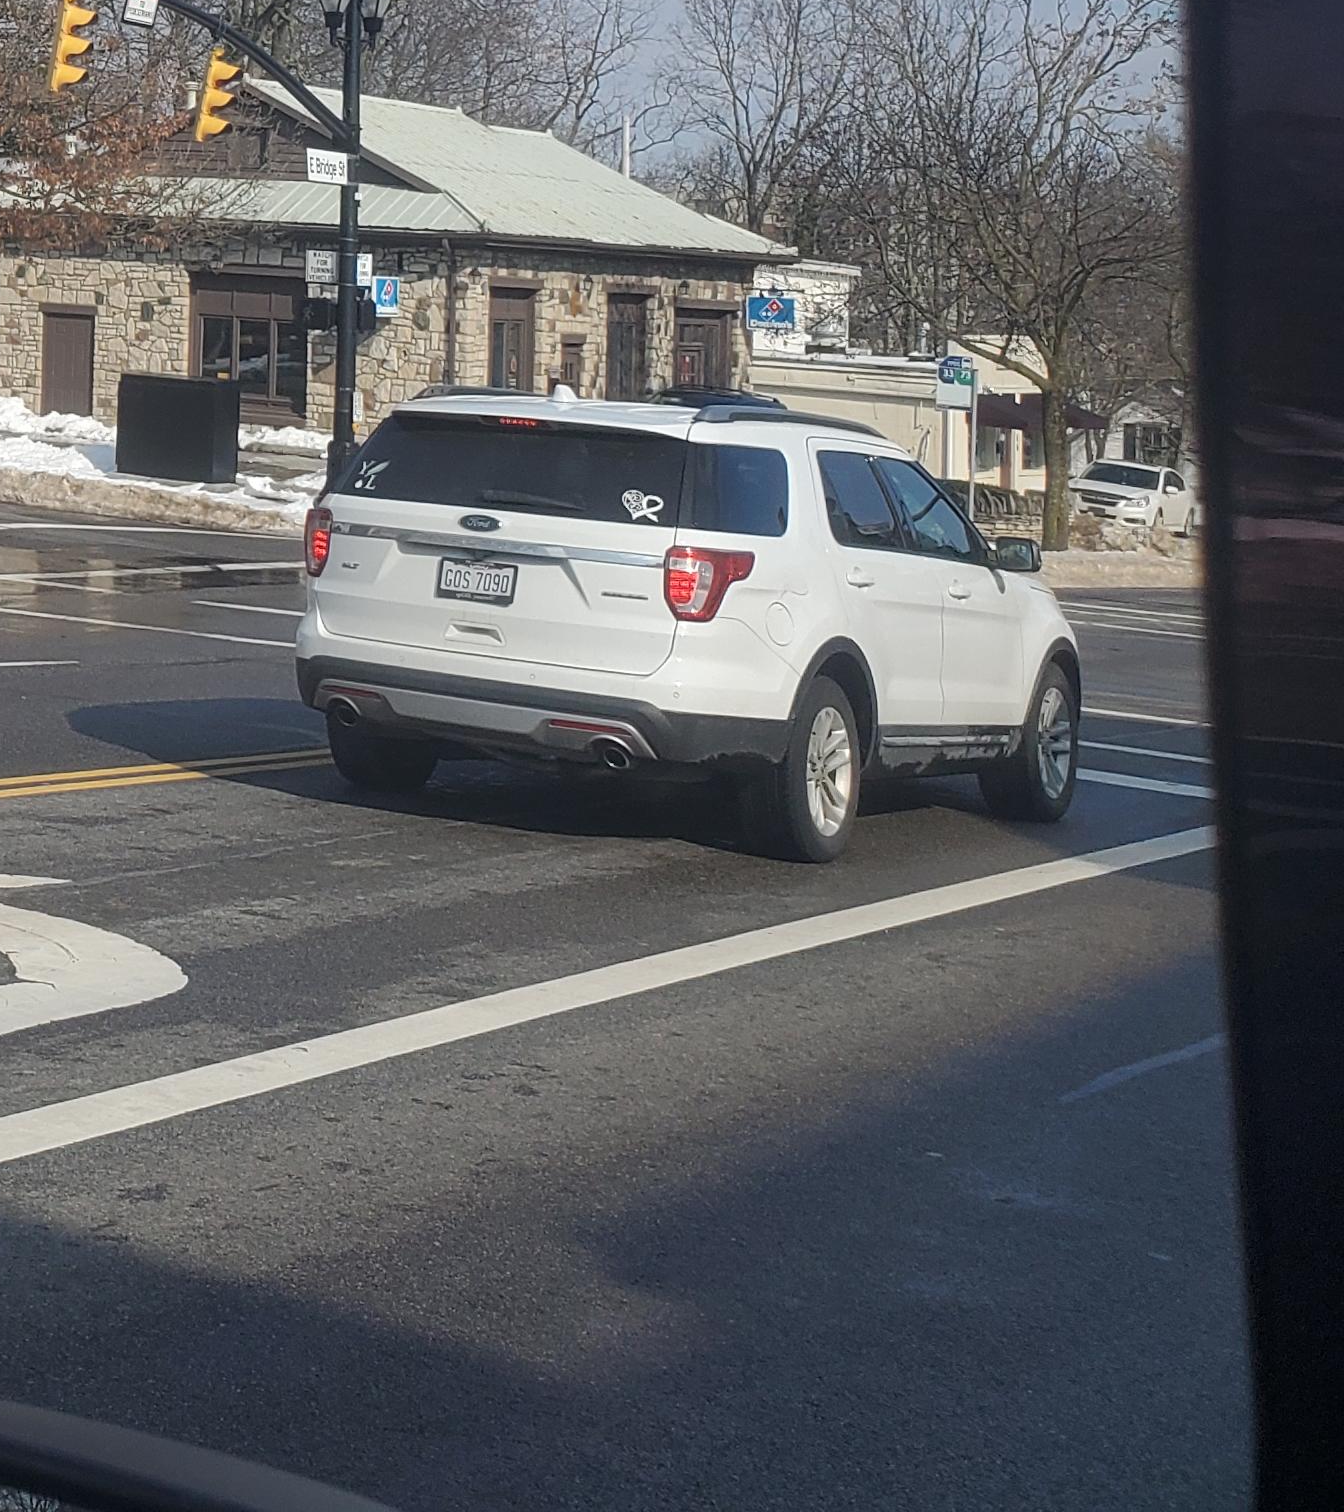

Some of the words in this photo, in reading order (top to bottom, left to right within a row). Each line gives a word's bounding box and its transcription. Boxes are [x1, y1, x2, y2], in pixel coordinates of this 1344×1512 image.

[309, 156, 314, 174] E
[315, 157, 337, 180] Bridge
[338, 160, 345, 177] St
[466, 517, 491, 528] Ford
[475, 571, 510, 594] 7090
